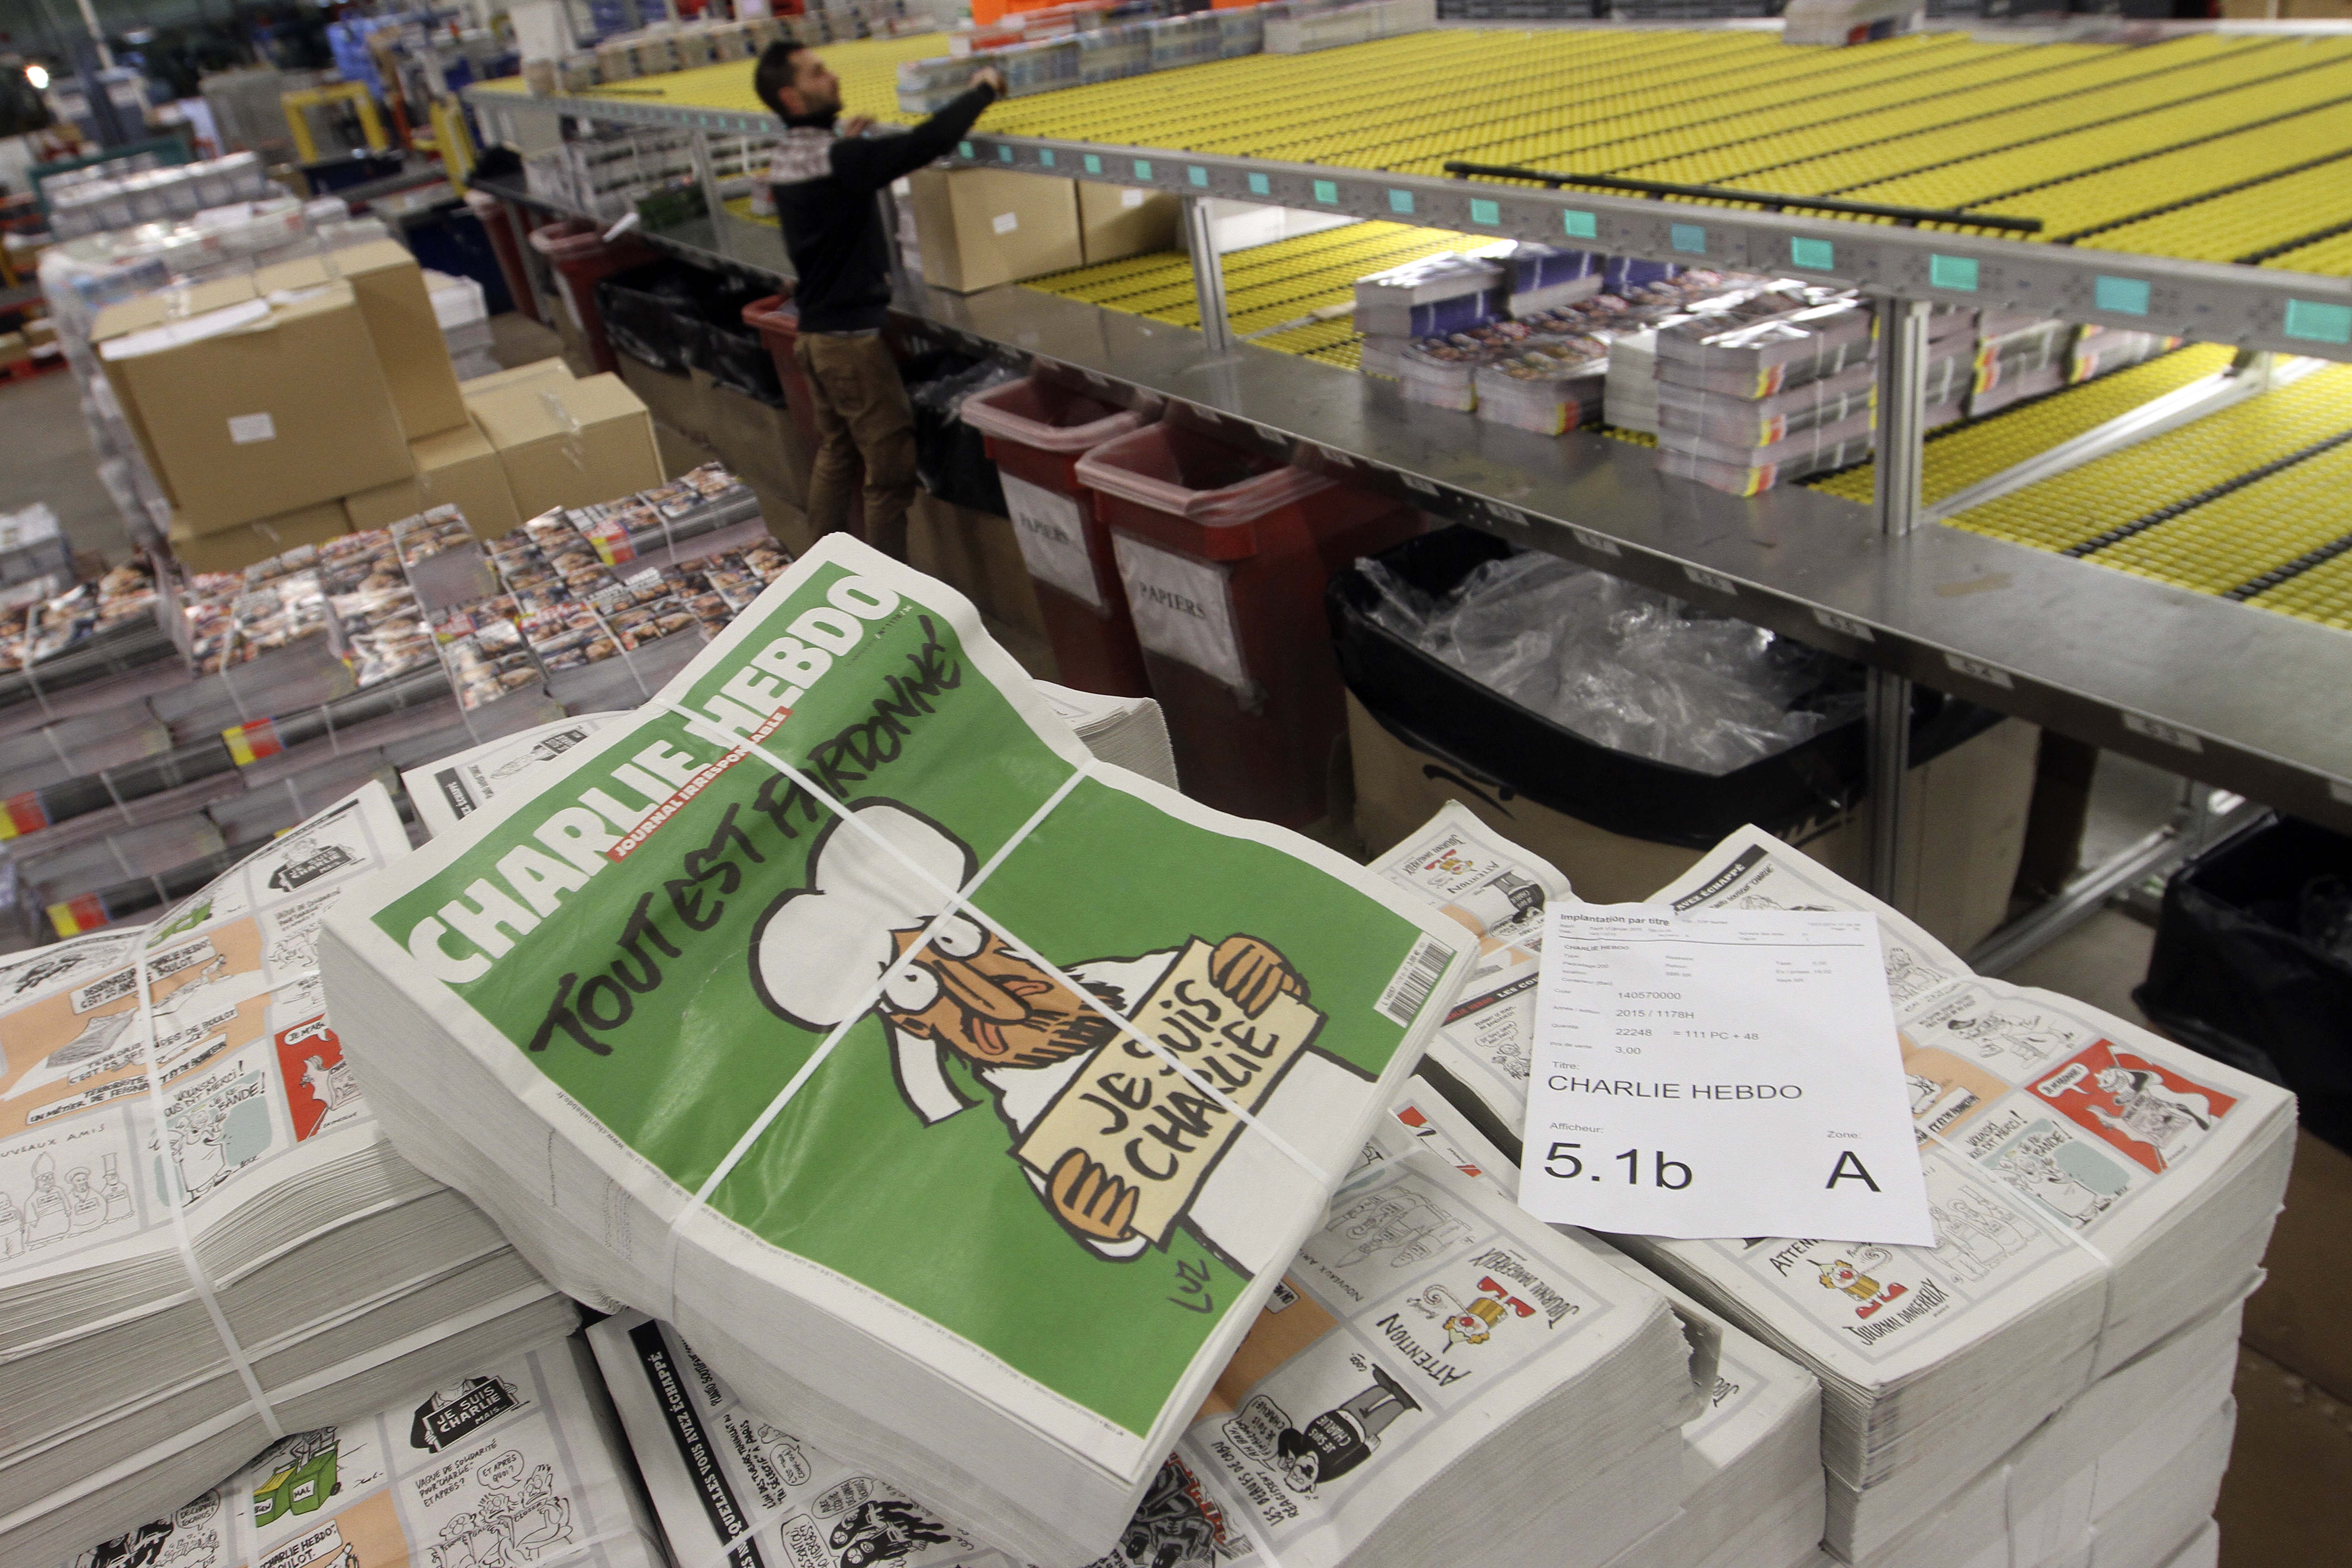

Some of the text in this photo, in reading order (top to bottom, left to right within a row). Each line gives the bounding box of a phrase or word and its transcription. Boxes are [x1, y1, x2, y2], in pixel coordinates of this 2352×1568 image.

[1138, 581, 1205, 619] PAPIERS
[408, 574, 902, 985] CHARLIE HEBDO
[613, 709, 789, 858] JOURNAL IRRESPONABLE
[1447, 861, 1499, 895] ATTENTION
[528, 893, 681, 1055] TOUT
[661, 803, 767, 931] EST
[1561, 913, 1625, 923] Implantation
[1649, 917, 1670, 926] titre
[1618, 991, 1681, 1000] 140570000
[1616, 1009, 1645, 1018] 2015
[1657, 1010, 1694, 1019] 1178H
[69, 1068, 103, 1085] C'EST
[103, 1061, 118, 1072] 25
[185, 1026, 199, 1036] DE
[202, 1009, 236, 1029] BOULOT
[288, 1032, 299, 1042] JE
[1615, 1028, 1652, 1036] 22248
[1685, 1030, 1706, 1039] 111
[1710, 1031, 1729, 1040] PC
[1744, 1033, 1759, 1041] 48
[1079, 980, 1221, 1135] JE SUIS
[1615, 1046, 1641, 1055] 3.00
[1552, 1061, 1580, 1070] Titre:
[184, 1095, 204, 1108] DIT
[206, 1072, 237, 1096] MERCI
[208, 1096, 223, 1108] JE
[217, 1080, 261, 1112] BANDE
[1125, 1019, 1279, 1181] CHARLIE
[1548, 1075, 1803, 1100] CHARLIE HEBDO
[46, 1098, 86, 1118] MÉTIER
[90, 1094, 104, 1103] DE
[556, 1091, 623, 1150] www.charliehebdo.fr
[66, 1123, 106, 1142] AMIS
[1549, 1122, 1604, 1135] Afficheur:
[1827, 1130, 1862, 1139] Zone:
[1544, 1142, 1693, 1190] 5.1b
[1825, 1151, 1882, 1193] A
[1842, 1317, 1904, 1346] JOURNAL
[1376, 1312, 1472, 1387] ATTENTION
[649, 1351, 685, 1413] ÉCHAPPÉ
[436, 1408, 456, 1425] JE
[459, 1384, 496, 1411] SUIS
[439, 1393, 502, 1433] CHARLIE
[676, 1409, 701, 1444] AVEZ
[740, 1419, 758, 1444] PARIS
[1251, 1416, 1267, 1435] SUIS
[1315, 1414, 1352, 1447] CHARLIE
[1243, 1446, 1260, 1457] AH
[1308, 1428, 1337, 1454] JE SUIS
[481, 1453, 518, 1478] ET APRÈS
[691, 1443, 711, 1474] VOUS
[740, 1449, 761, 1479] TUEURS
[415, 1469, 441, 1490] VAGUE
[441, 1463, 454, 1477] DE
[754, 1474, 769, 1492] DES
[1212, 1441, 1285, 1526] LES BEAUFS DE CABU
[293, 1486, 311, 1498] MAL
[513, 1500, 544, 1523] CLOSER
